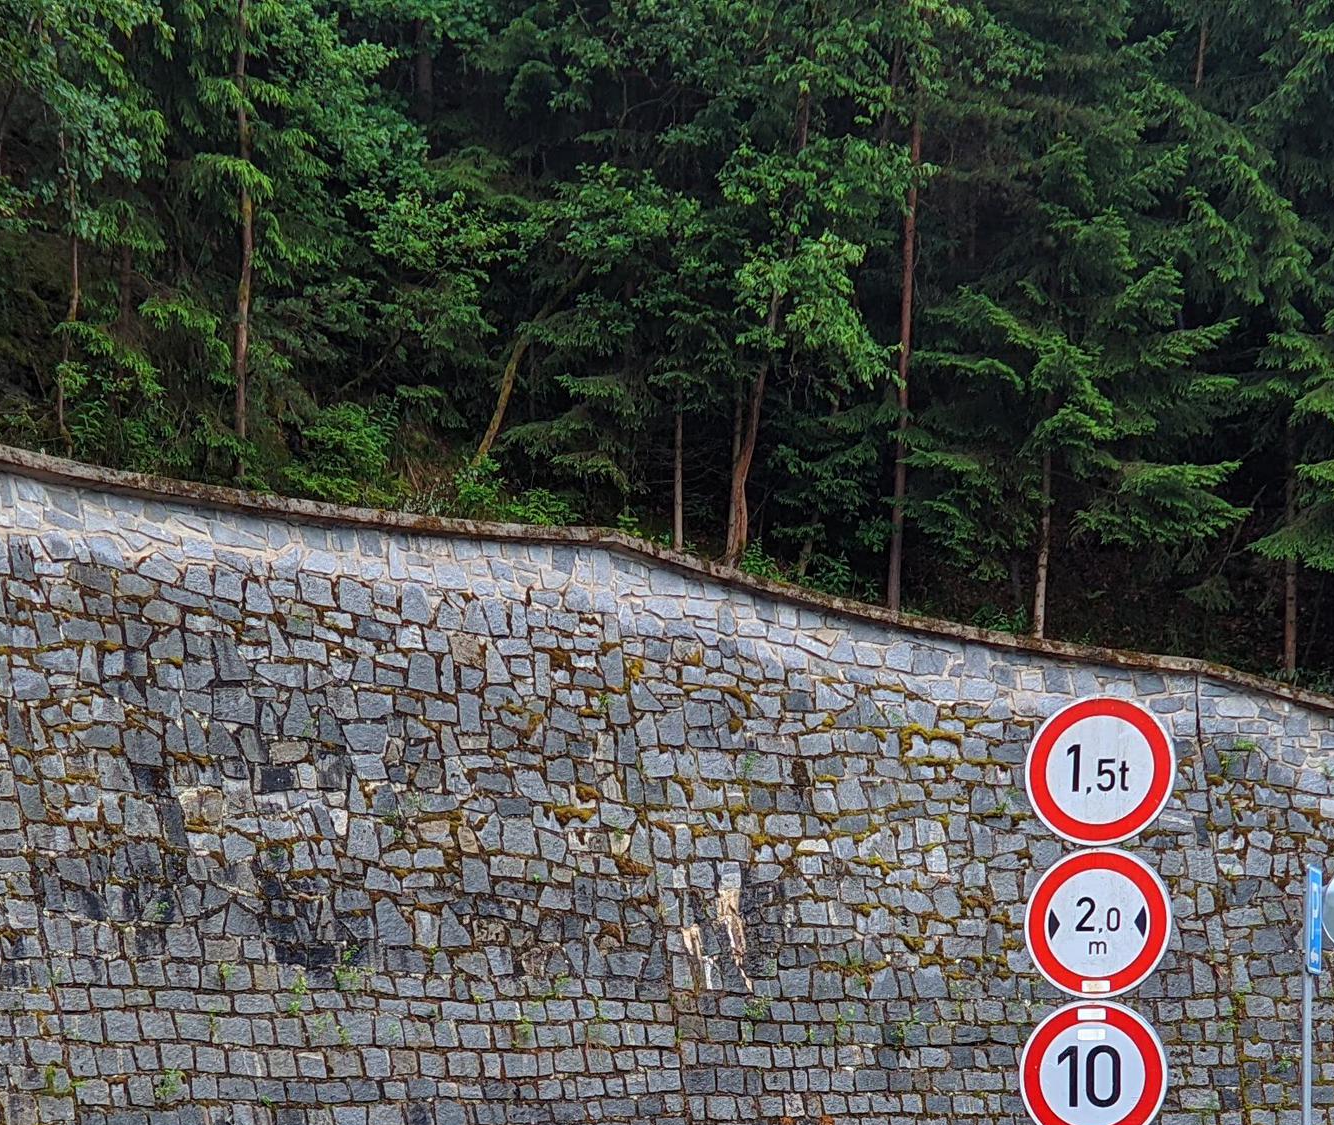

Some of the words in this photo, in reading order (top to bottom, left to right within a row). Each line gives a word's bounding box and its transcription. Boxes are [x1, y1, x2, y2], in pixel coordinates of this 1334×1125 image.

[1066, 743, 1130, 795] 1,5t
[1075, 896, 1121, 934] 2,0
[1088, 941, 1107, 955] m
[1057, 1044, 1122, 1108] 10
